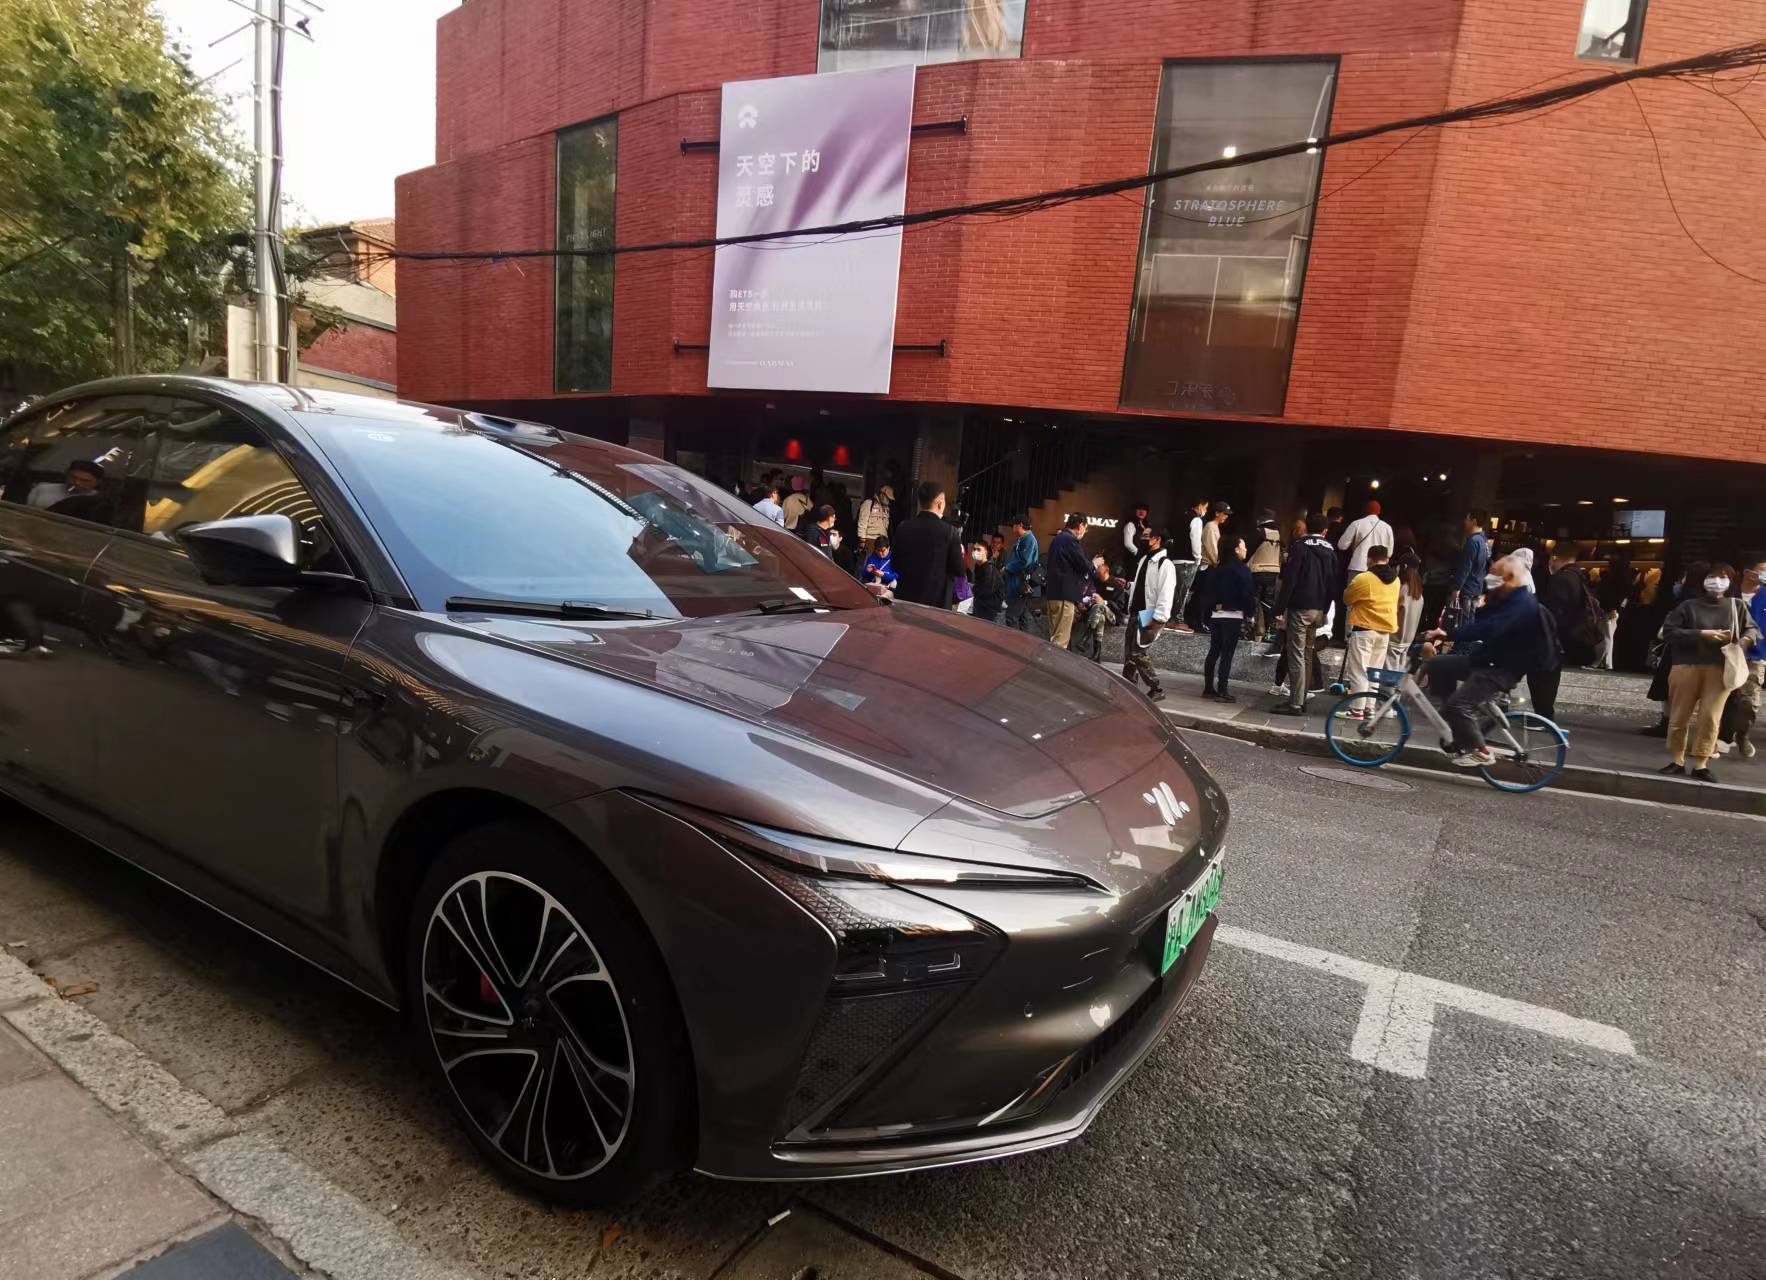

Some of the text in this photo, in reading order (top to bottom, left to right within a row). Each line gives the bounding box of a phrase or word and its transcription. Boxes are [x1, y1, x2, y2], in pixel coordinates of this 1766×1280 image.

[736, 149, 820, 177] 天空下的
[736, 184, 774, 207] 灵感
[1173, 199, 1287, 212] STRATOSPHERE
[1207, 215, 1247, 228] BLUE
